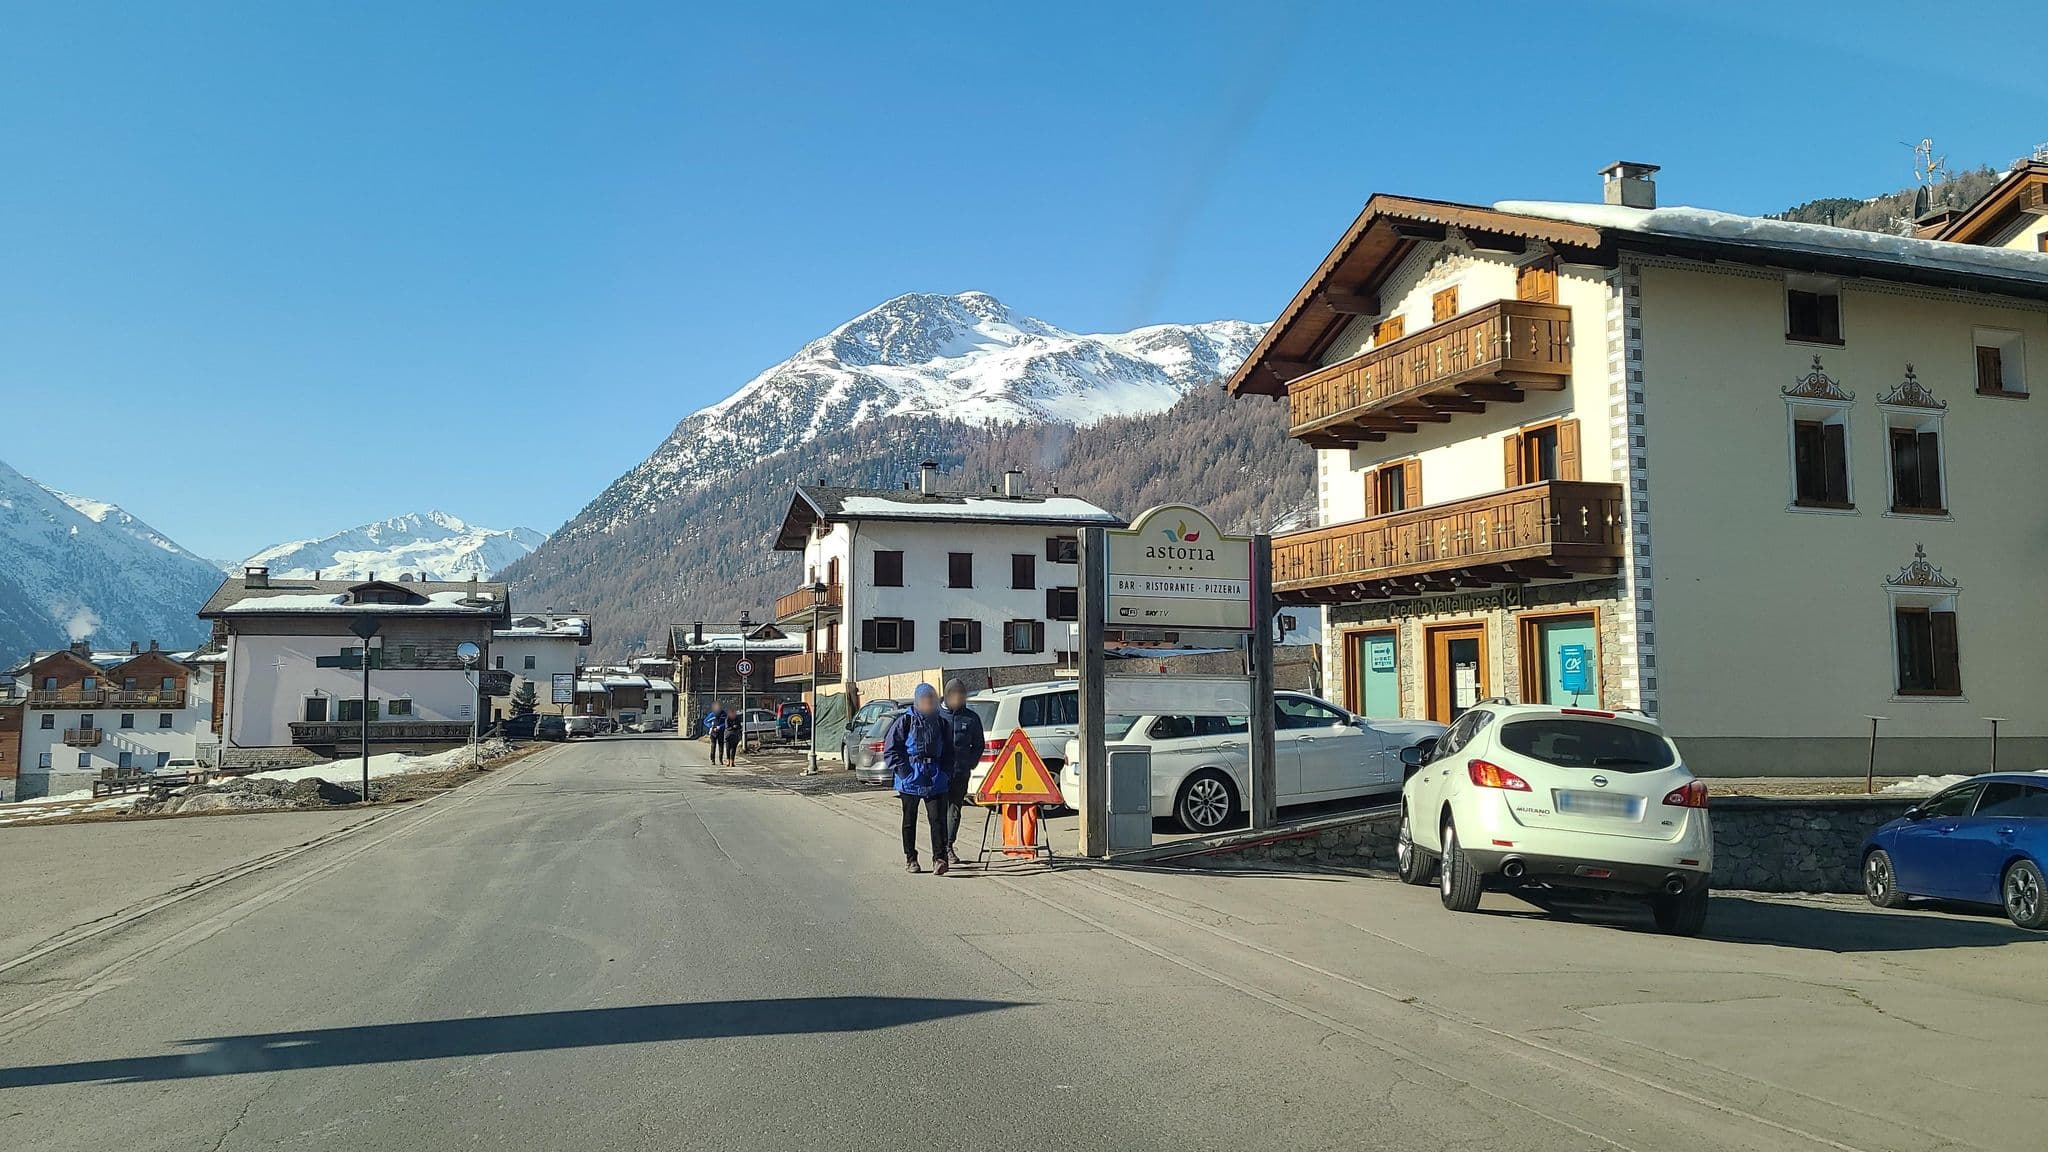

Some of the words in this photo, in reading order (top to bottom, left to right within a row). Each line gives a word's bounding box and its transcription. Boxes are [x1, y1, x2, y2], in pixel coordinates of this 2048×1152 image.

[1146, 546, 1216, 561] astoria
[1119, 581, 1135, 590] BAR
[1146, 582, 1194, 592] RISTORANTE
[1205, 584, 1241, 594] PIZZERIA
[1388, 600, 1428, 618] Credito
[1430, 593, 1499, 614] Valtellinese
[740, 664, 750, 672] 30
